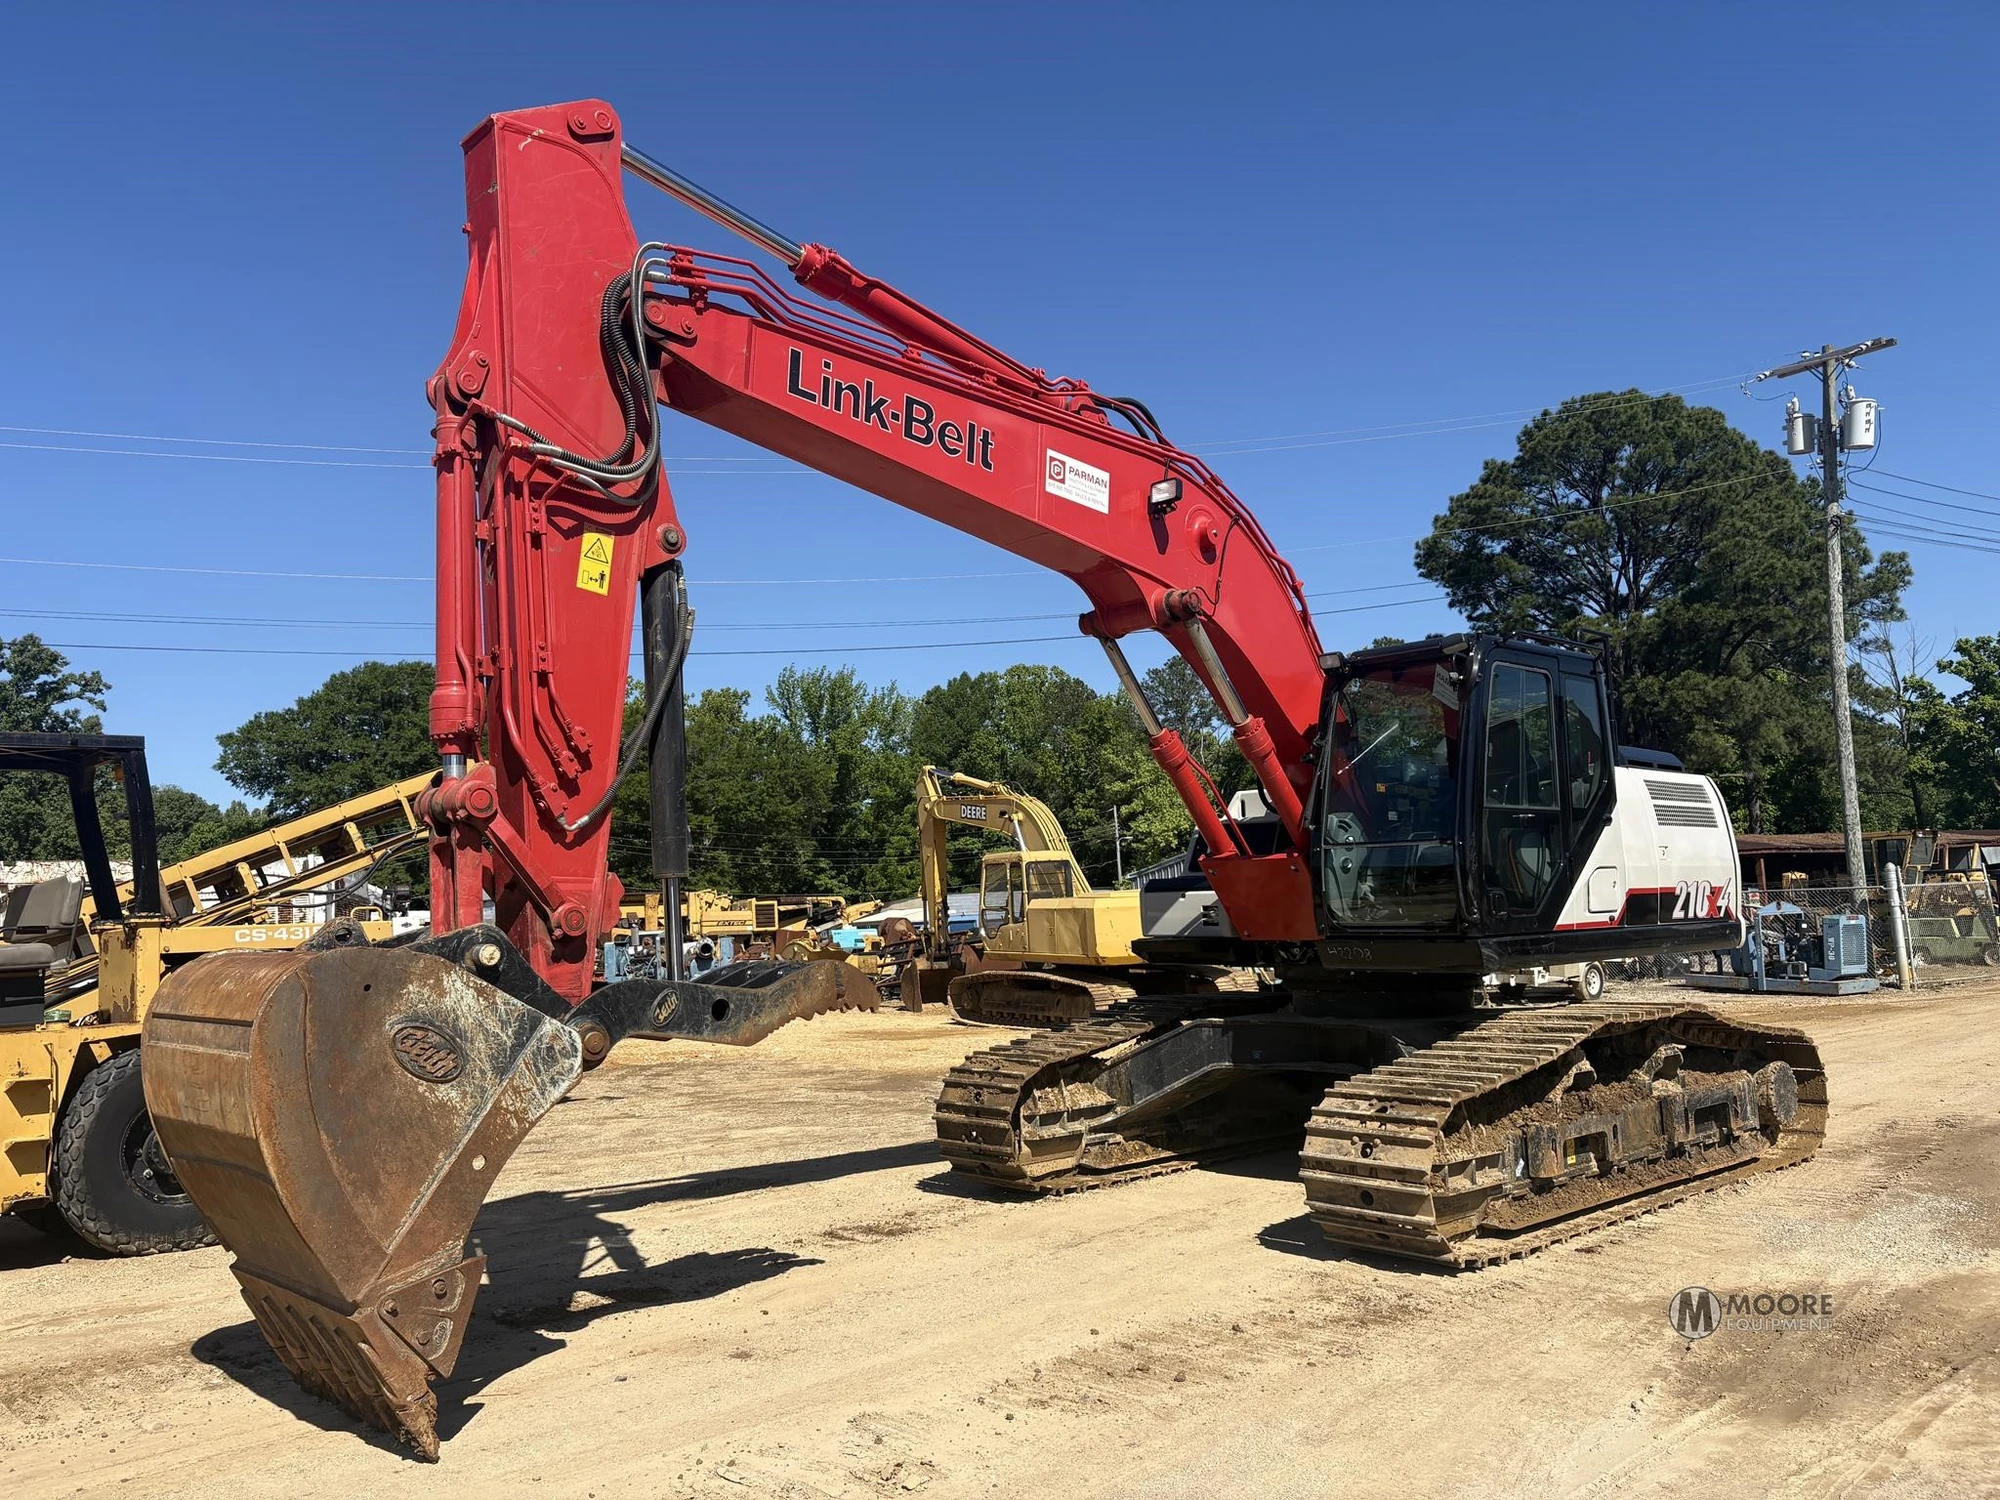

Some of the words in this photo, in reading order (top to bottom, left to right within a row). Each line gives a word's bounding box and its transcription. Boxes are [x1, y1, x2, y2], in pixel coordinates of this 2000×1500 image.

[787, 346, 994, 472] Link-Belt
[1069, 466, 1108, 489] PARMAN
[961, 805, 986, 819] DEERE
